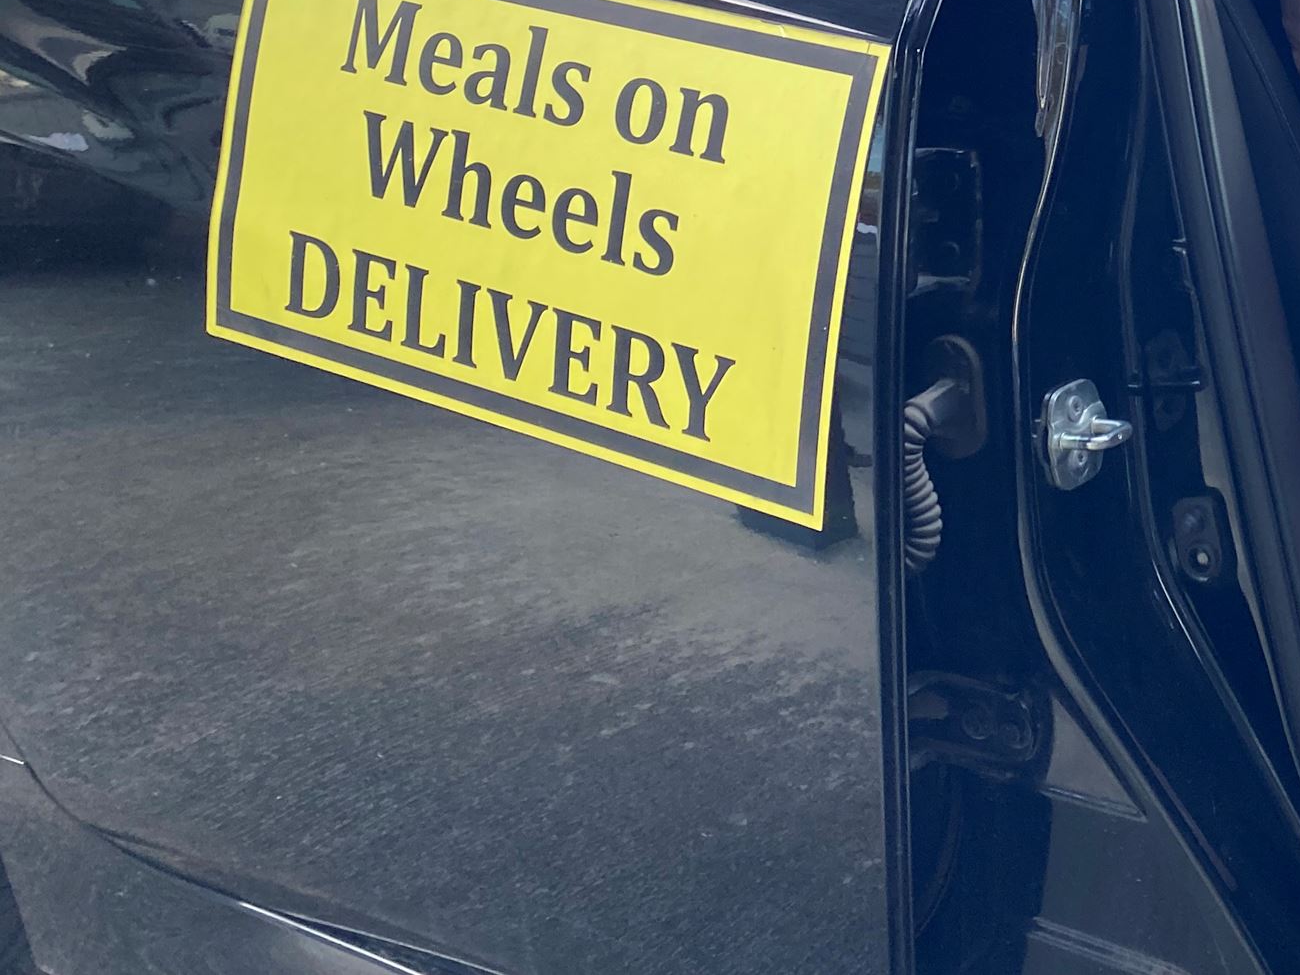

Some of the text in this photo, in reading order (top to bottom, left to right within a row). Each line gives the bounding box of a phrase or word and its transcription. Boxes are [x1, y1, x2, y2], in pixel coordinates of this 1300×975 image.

[363, 110, 679, 276] Wheels
[615, 77, 729, 164] on
[284, 230, 736, 442] DELIVERY
